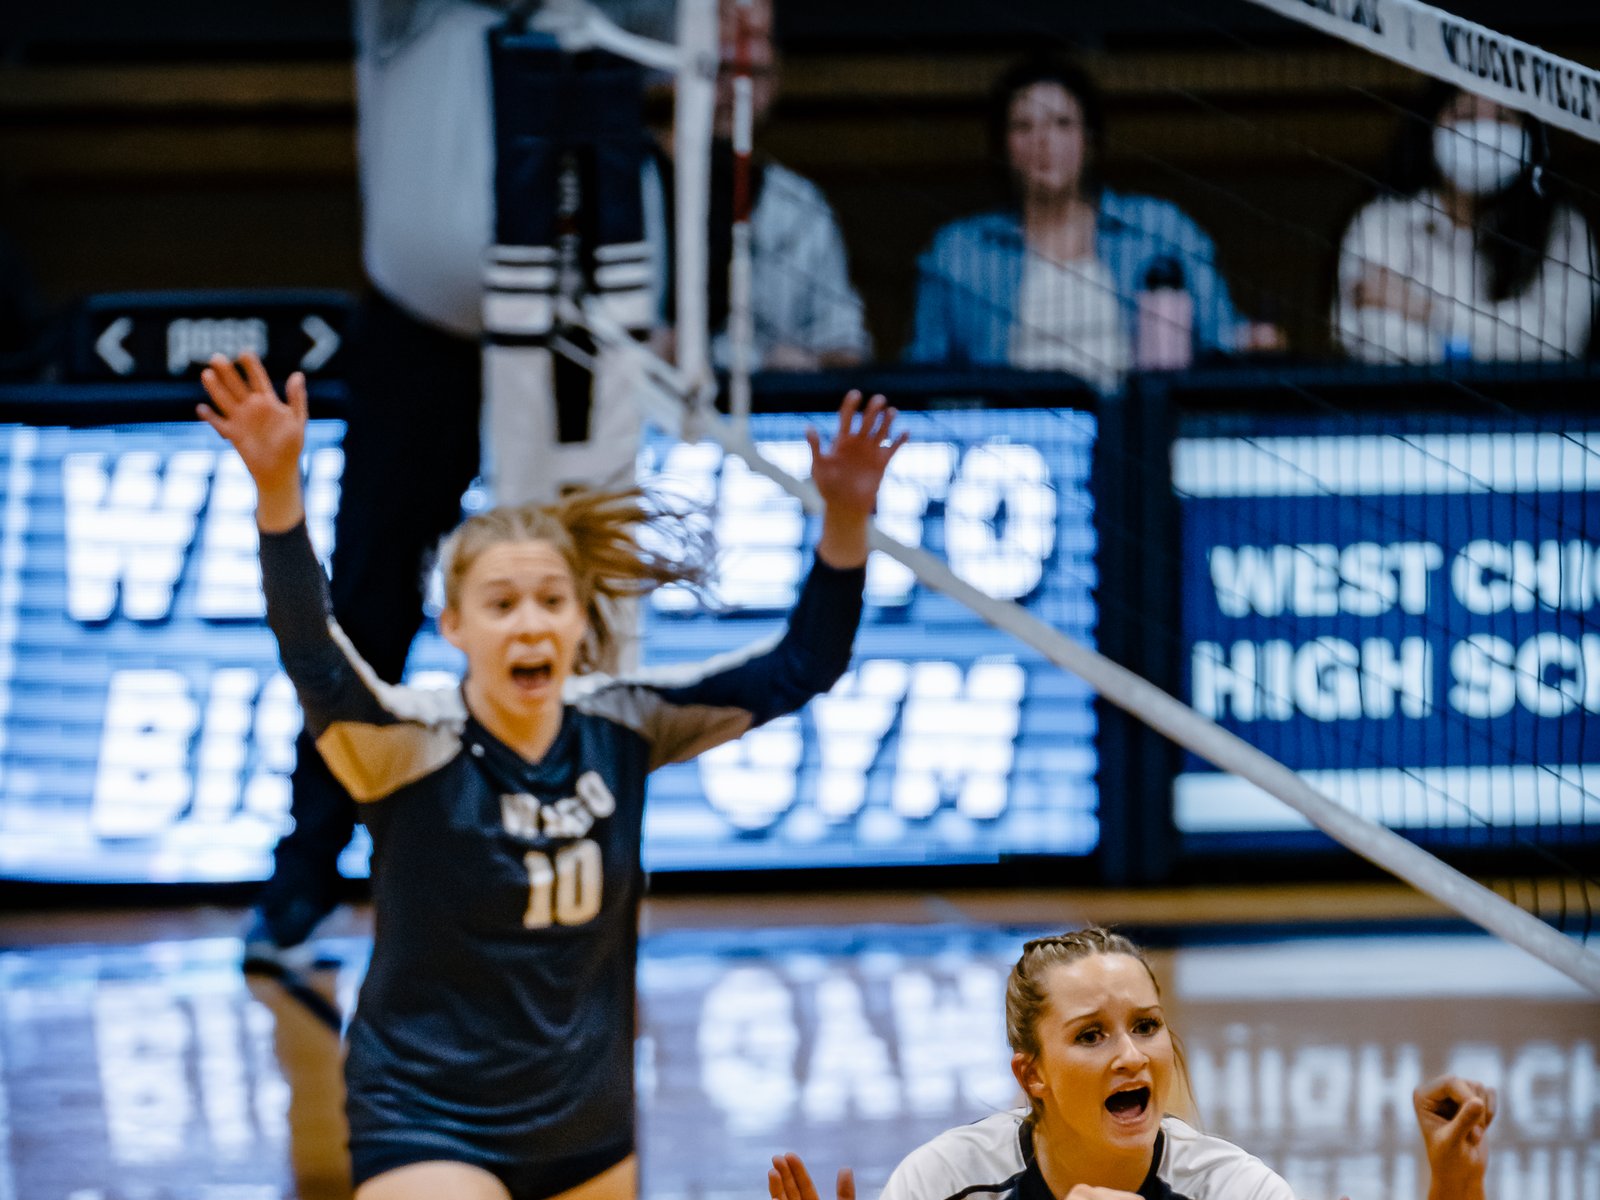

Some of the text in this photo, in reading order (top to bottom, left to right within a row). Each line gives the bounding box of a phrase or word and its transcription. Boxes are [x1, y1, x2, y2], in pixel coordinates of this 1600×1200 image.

[1207, 538, 1600, 618] WEST CHI
[1191, 635, 1434, 722] HIGH
[522, 838, 604, 930] 10
